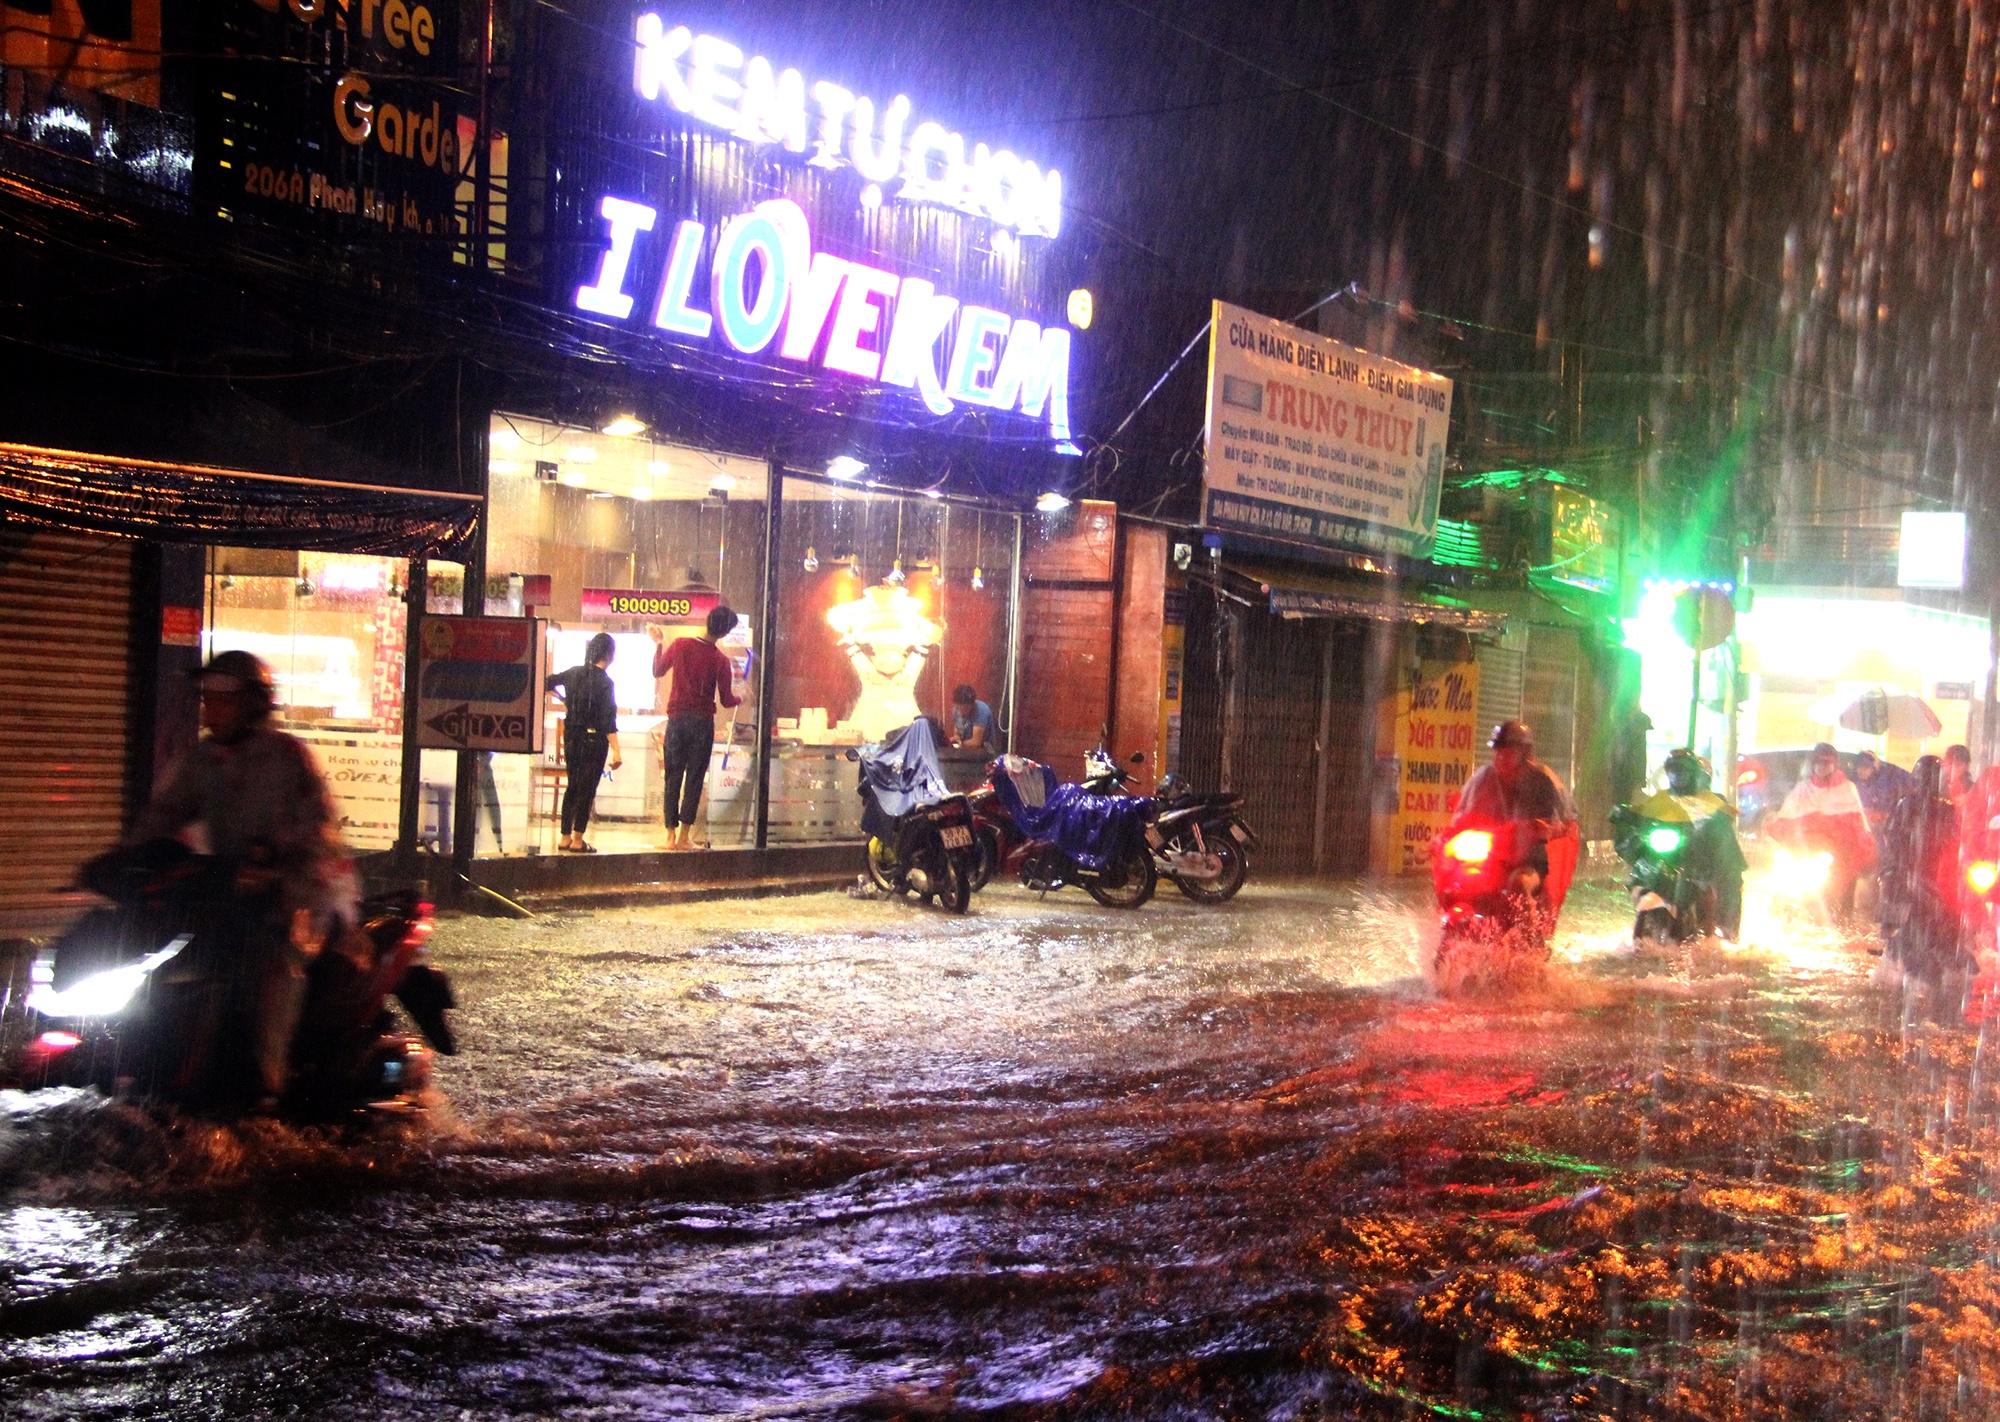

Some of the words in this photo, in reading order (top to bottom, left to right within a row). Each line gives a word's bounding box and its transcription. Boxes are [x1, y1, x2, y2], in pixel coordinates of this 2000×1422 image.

[333, 74, 460, 175] Garde
[634, 12, 805, 153] KEM
[310, 173, 356, 214] Phan
[576, 194, 657, 319] I
[1229, 316, 1255, 352] CỬA
[1259, 329, 1294, 364] HÀNG
[1298, 344, 1325, 377] ĐIỆN
[1329, 355, 1359, 385] LẠNH
[1368, 367, 1393, 398] ĐIỆN
[1397, 379, 1414, 401] GIA
[1418, 385, 1445, 413] DỤNG
[1266, 380, 1349, 439] TRUNG
[610, 597, 691, 615] 19009059
